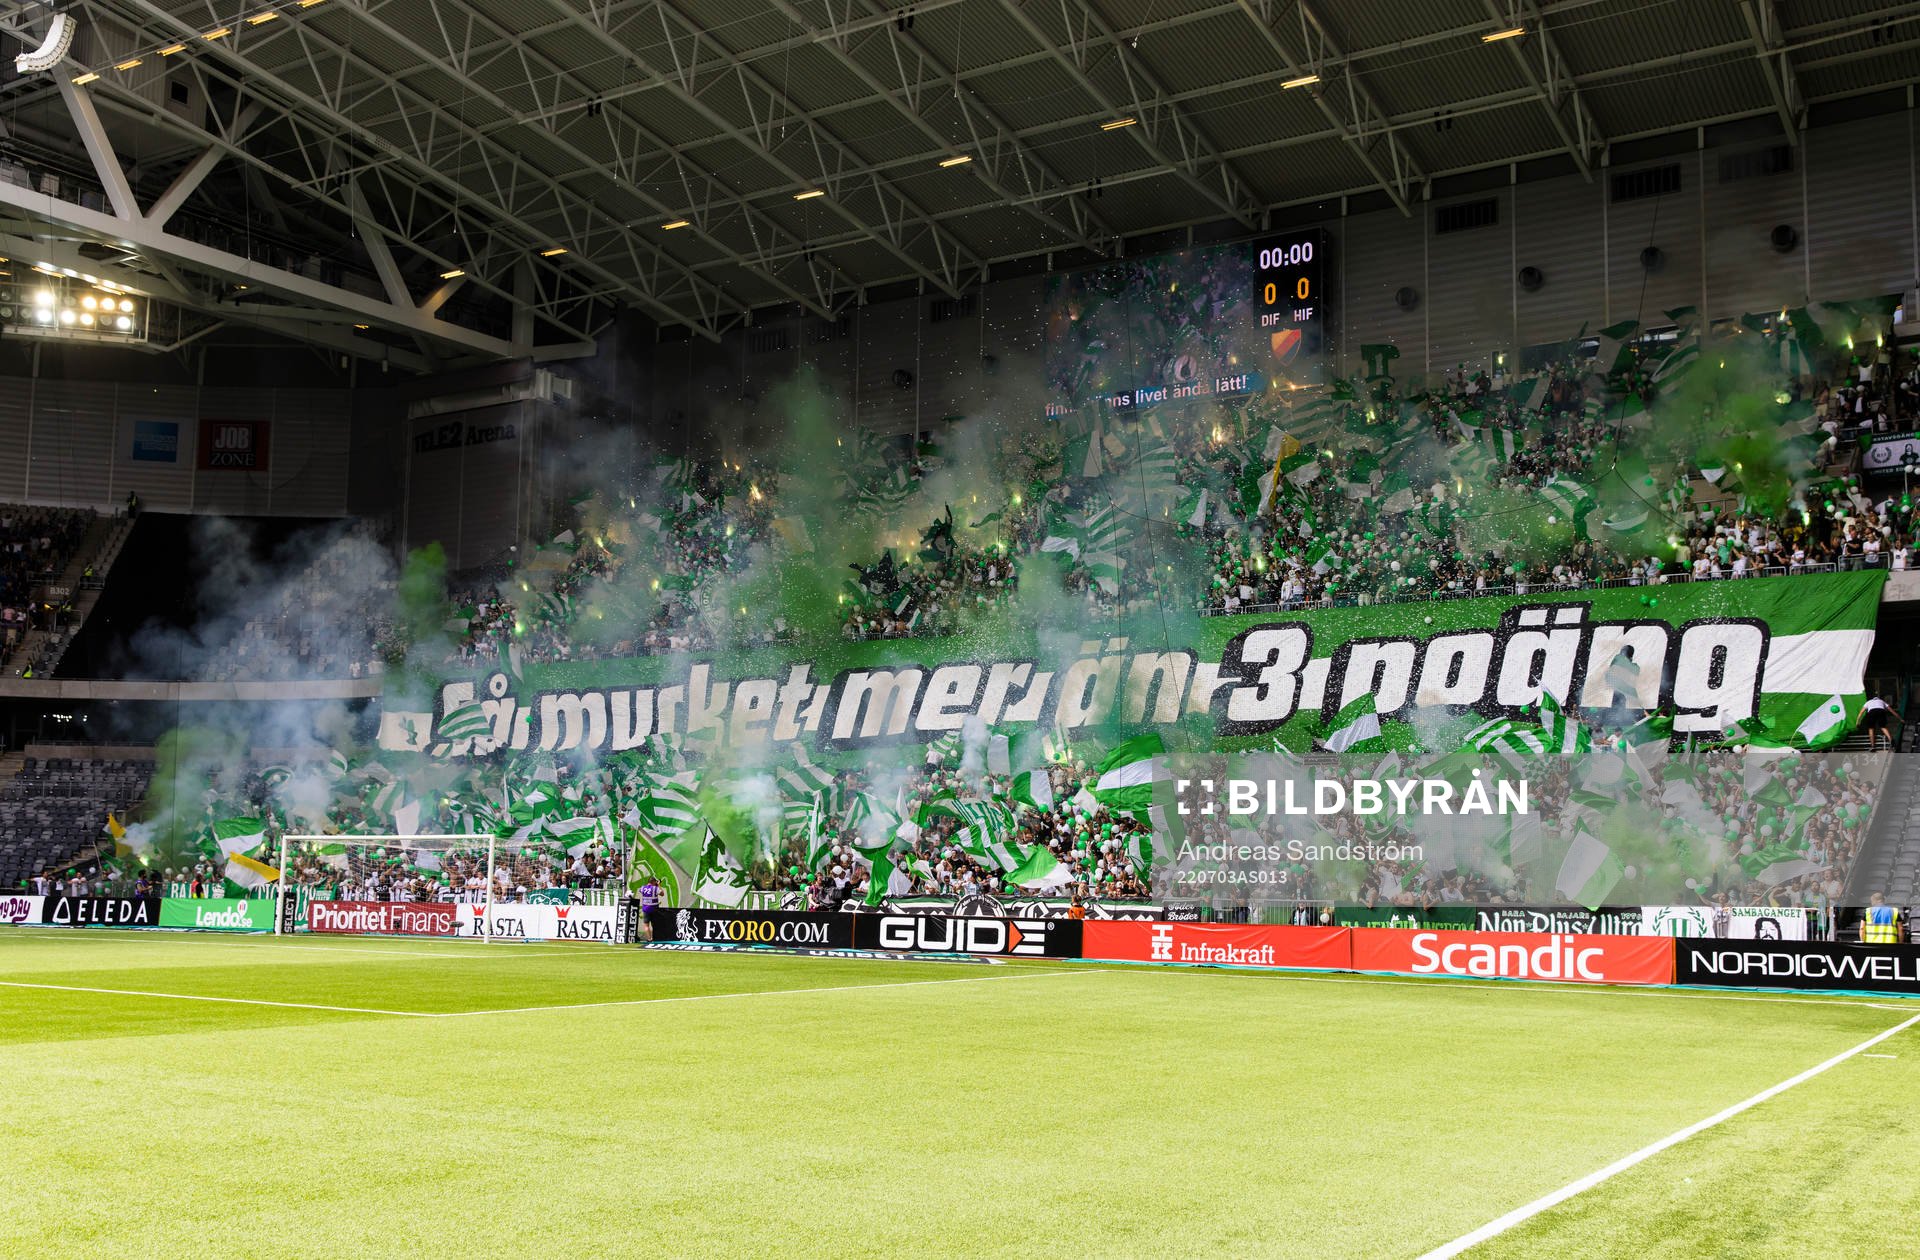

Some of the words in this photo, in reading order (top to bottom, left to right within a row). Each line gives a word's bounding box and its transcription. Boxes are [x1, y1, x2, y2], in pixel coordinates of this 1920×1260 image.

[1259, 242, 1313, 270] 00:00
[1264, 283, 1276, 305] 0
[1297, 277, 1309, 299] 0
[1261, 313, 1280, 327] DIF
[1293, 308, 1313, 322] HIF
[1135, 389, 1168, 404] livet
[1216, 374, 1247, 394] lätt!
[215, 426, 249, 449] JOB
[465, 424, 515, 446] Arena
[210, 453, 255, 466] ZONE
[832, 662, 1032, 739] mer
[1056, 637, 1190, 732] än
[1226, 626, 1309, 721] 3
[77, 899, 148, 923] ELEDA
[284, 897, 294, 933] SELECT
[313, 903, 388, 931] Prioritet
[390, 905, 451, 932] Finans
[616, 904, 627, 943] SELECT
[628, 904, 638, 943] SELECT
[556, 919, 613, 940] RASTA
[703, 919, 830, 943] FXORO.COM
[880, 915, 1046, 954] GUIDE
[1180, 942, 1275, 964] Infrakraft
[1411, 932, 1604, 980] Scandic
